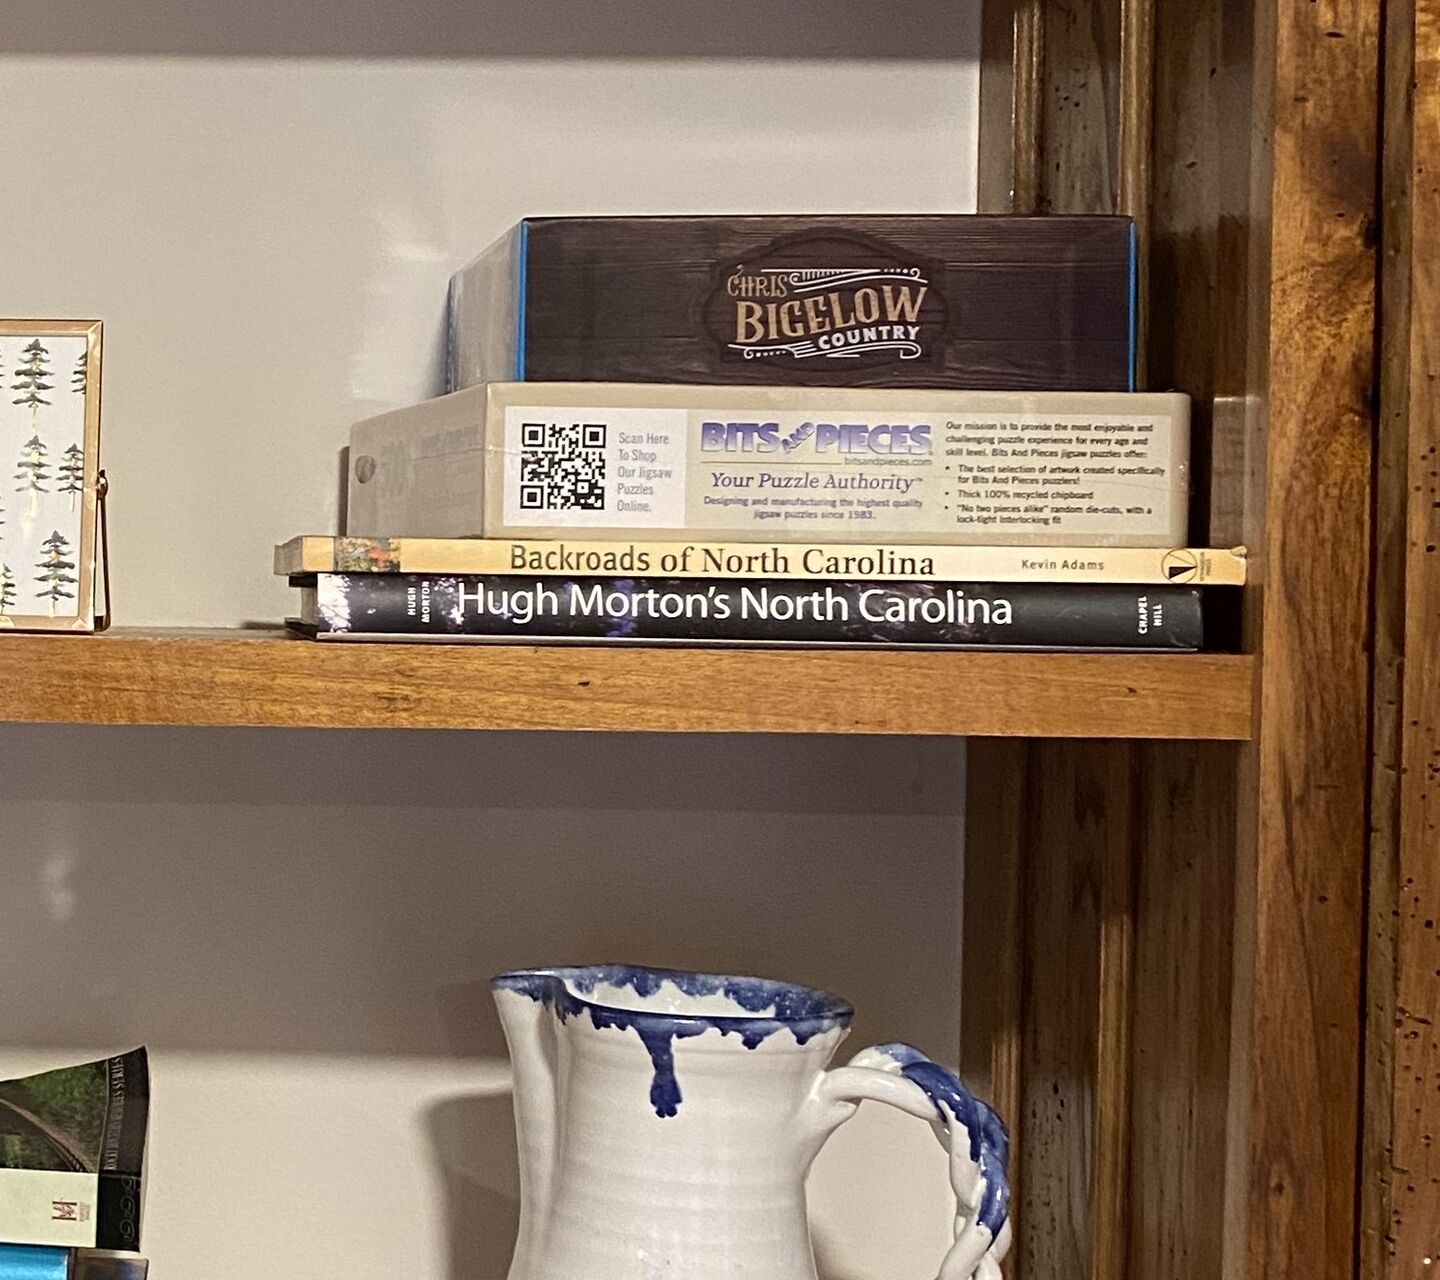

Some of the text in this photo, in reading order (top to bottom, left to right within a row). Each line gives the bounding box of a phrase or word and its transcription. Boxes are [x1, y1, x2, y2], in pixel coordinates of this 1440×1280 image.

[727, 265, 789, 298] CHRIS
[735, 284, 929, 345] BIGELOW
[817, 325, 921, 351] COUNTRY
[618, 432, 670, 446] Scan Here
[701, 421, 781, 454] BITS
[816, 423, 933, 456] PIECES
[618, 450, 658, 463] To Shop
[844, 456, 933, 468] bitsandpieces.com
[617, 467, 673, 483] Our Jigsaw
[711, 472, 754, 489] Your
[758, 472, 820, 490] Puzzle
[617, 483, 655, 497] Puzzles
[617, 500, 652, 513] Online.
[510, 543, 937, 577] Backroads of North Carolina
[1020, 557, 1106, 573] Kevin Adams
[407, 586, 418, 617] HUGH
[420, 581, 430, 624] MORTON
[459, 582, 1013, 625] Hugh Morton's North Carolina
[1137, 595, 1149, 635] CHAPEL
[1152, 604, 1163, 627] HILL
